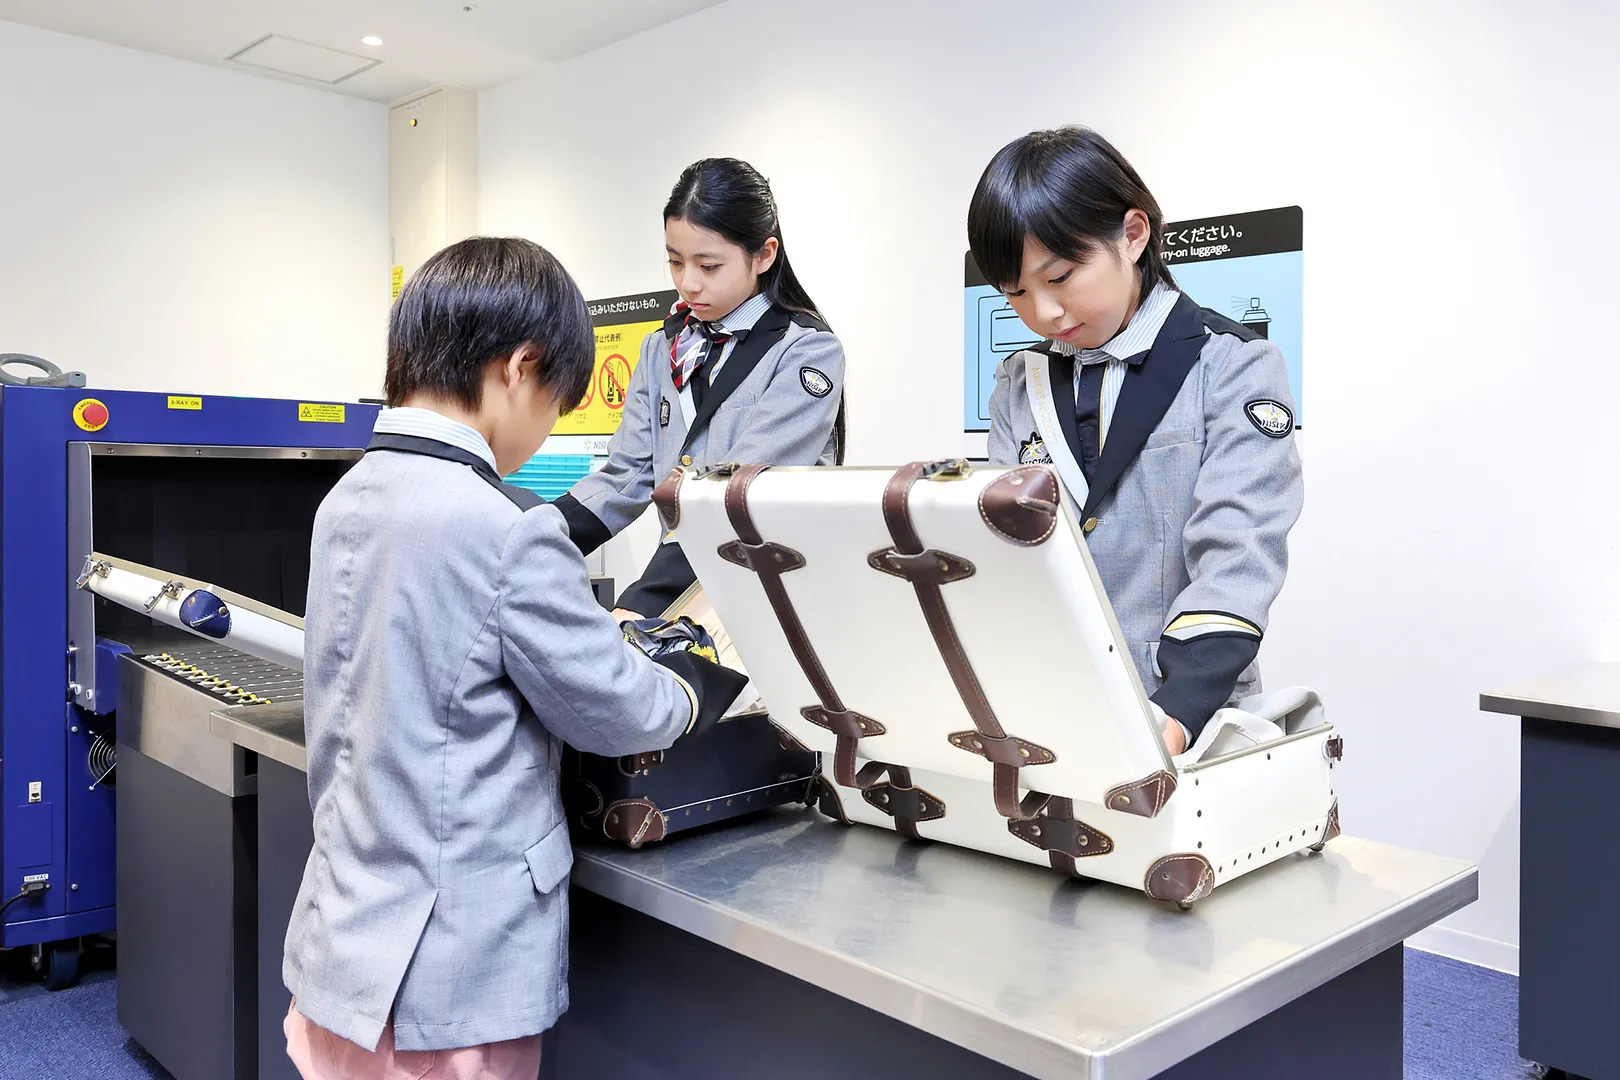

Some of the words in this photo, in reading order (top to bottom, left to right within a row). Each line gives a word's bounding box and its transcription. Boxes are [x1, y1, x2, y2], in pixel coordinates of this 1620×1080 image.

[1160, 224, 1243, 246] てください。
[1190, 244, 1231, 258] luggage.
